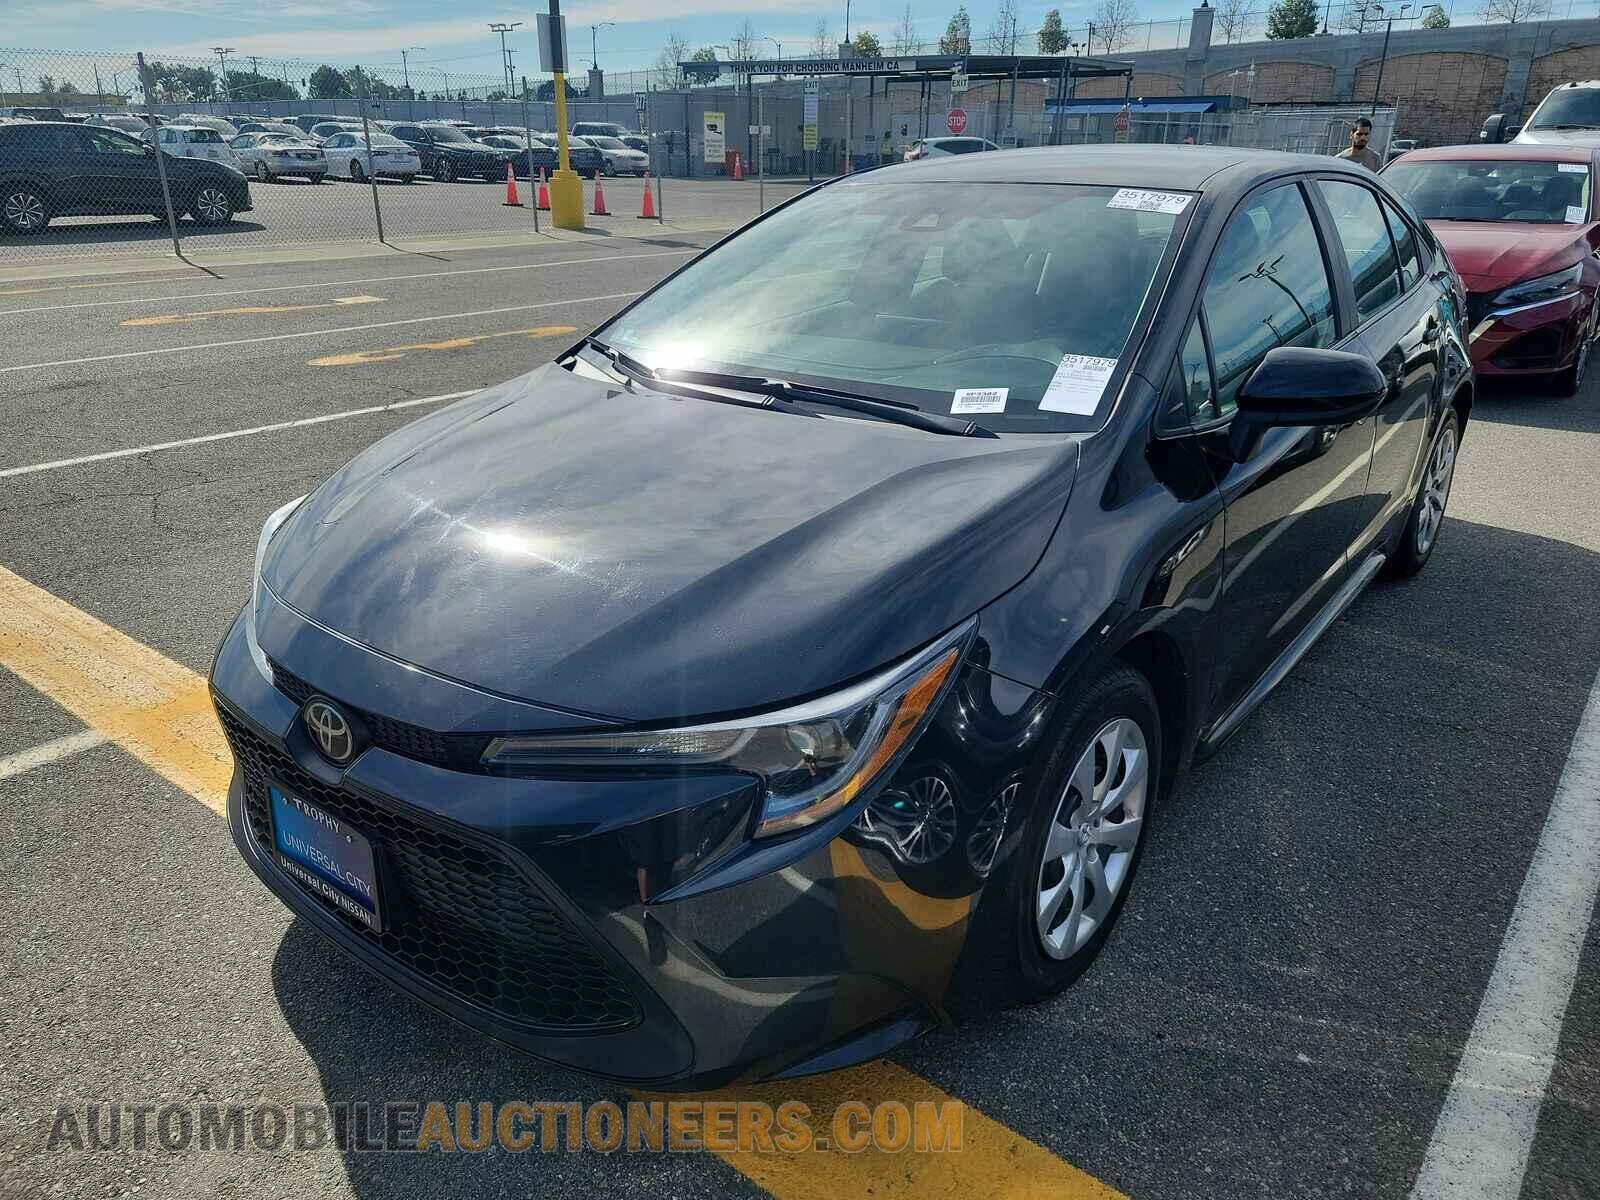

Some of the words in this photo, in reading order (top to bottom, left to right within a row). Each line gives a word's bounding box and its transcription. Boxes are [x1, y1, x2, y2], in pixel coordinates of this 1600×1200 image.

[730, 65, 756, 74] THANK
[758, 65, 775, 73] YOU
[777, 64, 794, 73] FOR
[795, 63, 840, 72] CHOOSING
[842, 62, 884, 71] MANHEIM
[886, 62, 899, 70] CA
[805, 81, 818, 89] EXIT
[952, 79, 967, 88] EXIT
[948, 116, 966, 127] STOP
[1118, 190, 1186, 204] 3517979
[1062, 354, 1117, 368] 3517979
[293, 798, 340, 833] TROPHY
[282, 830, 345, 880] UNIVERSAL
[345, 871, 371, 897] CITY
[280, 855, 320, 889] Universal
[322, 883, 340, 904] City
[341, 896, 371, 925] NISSAN
